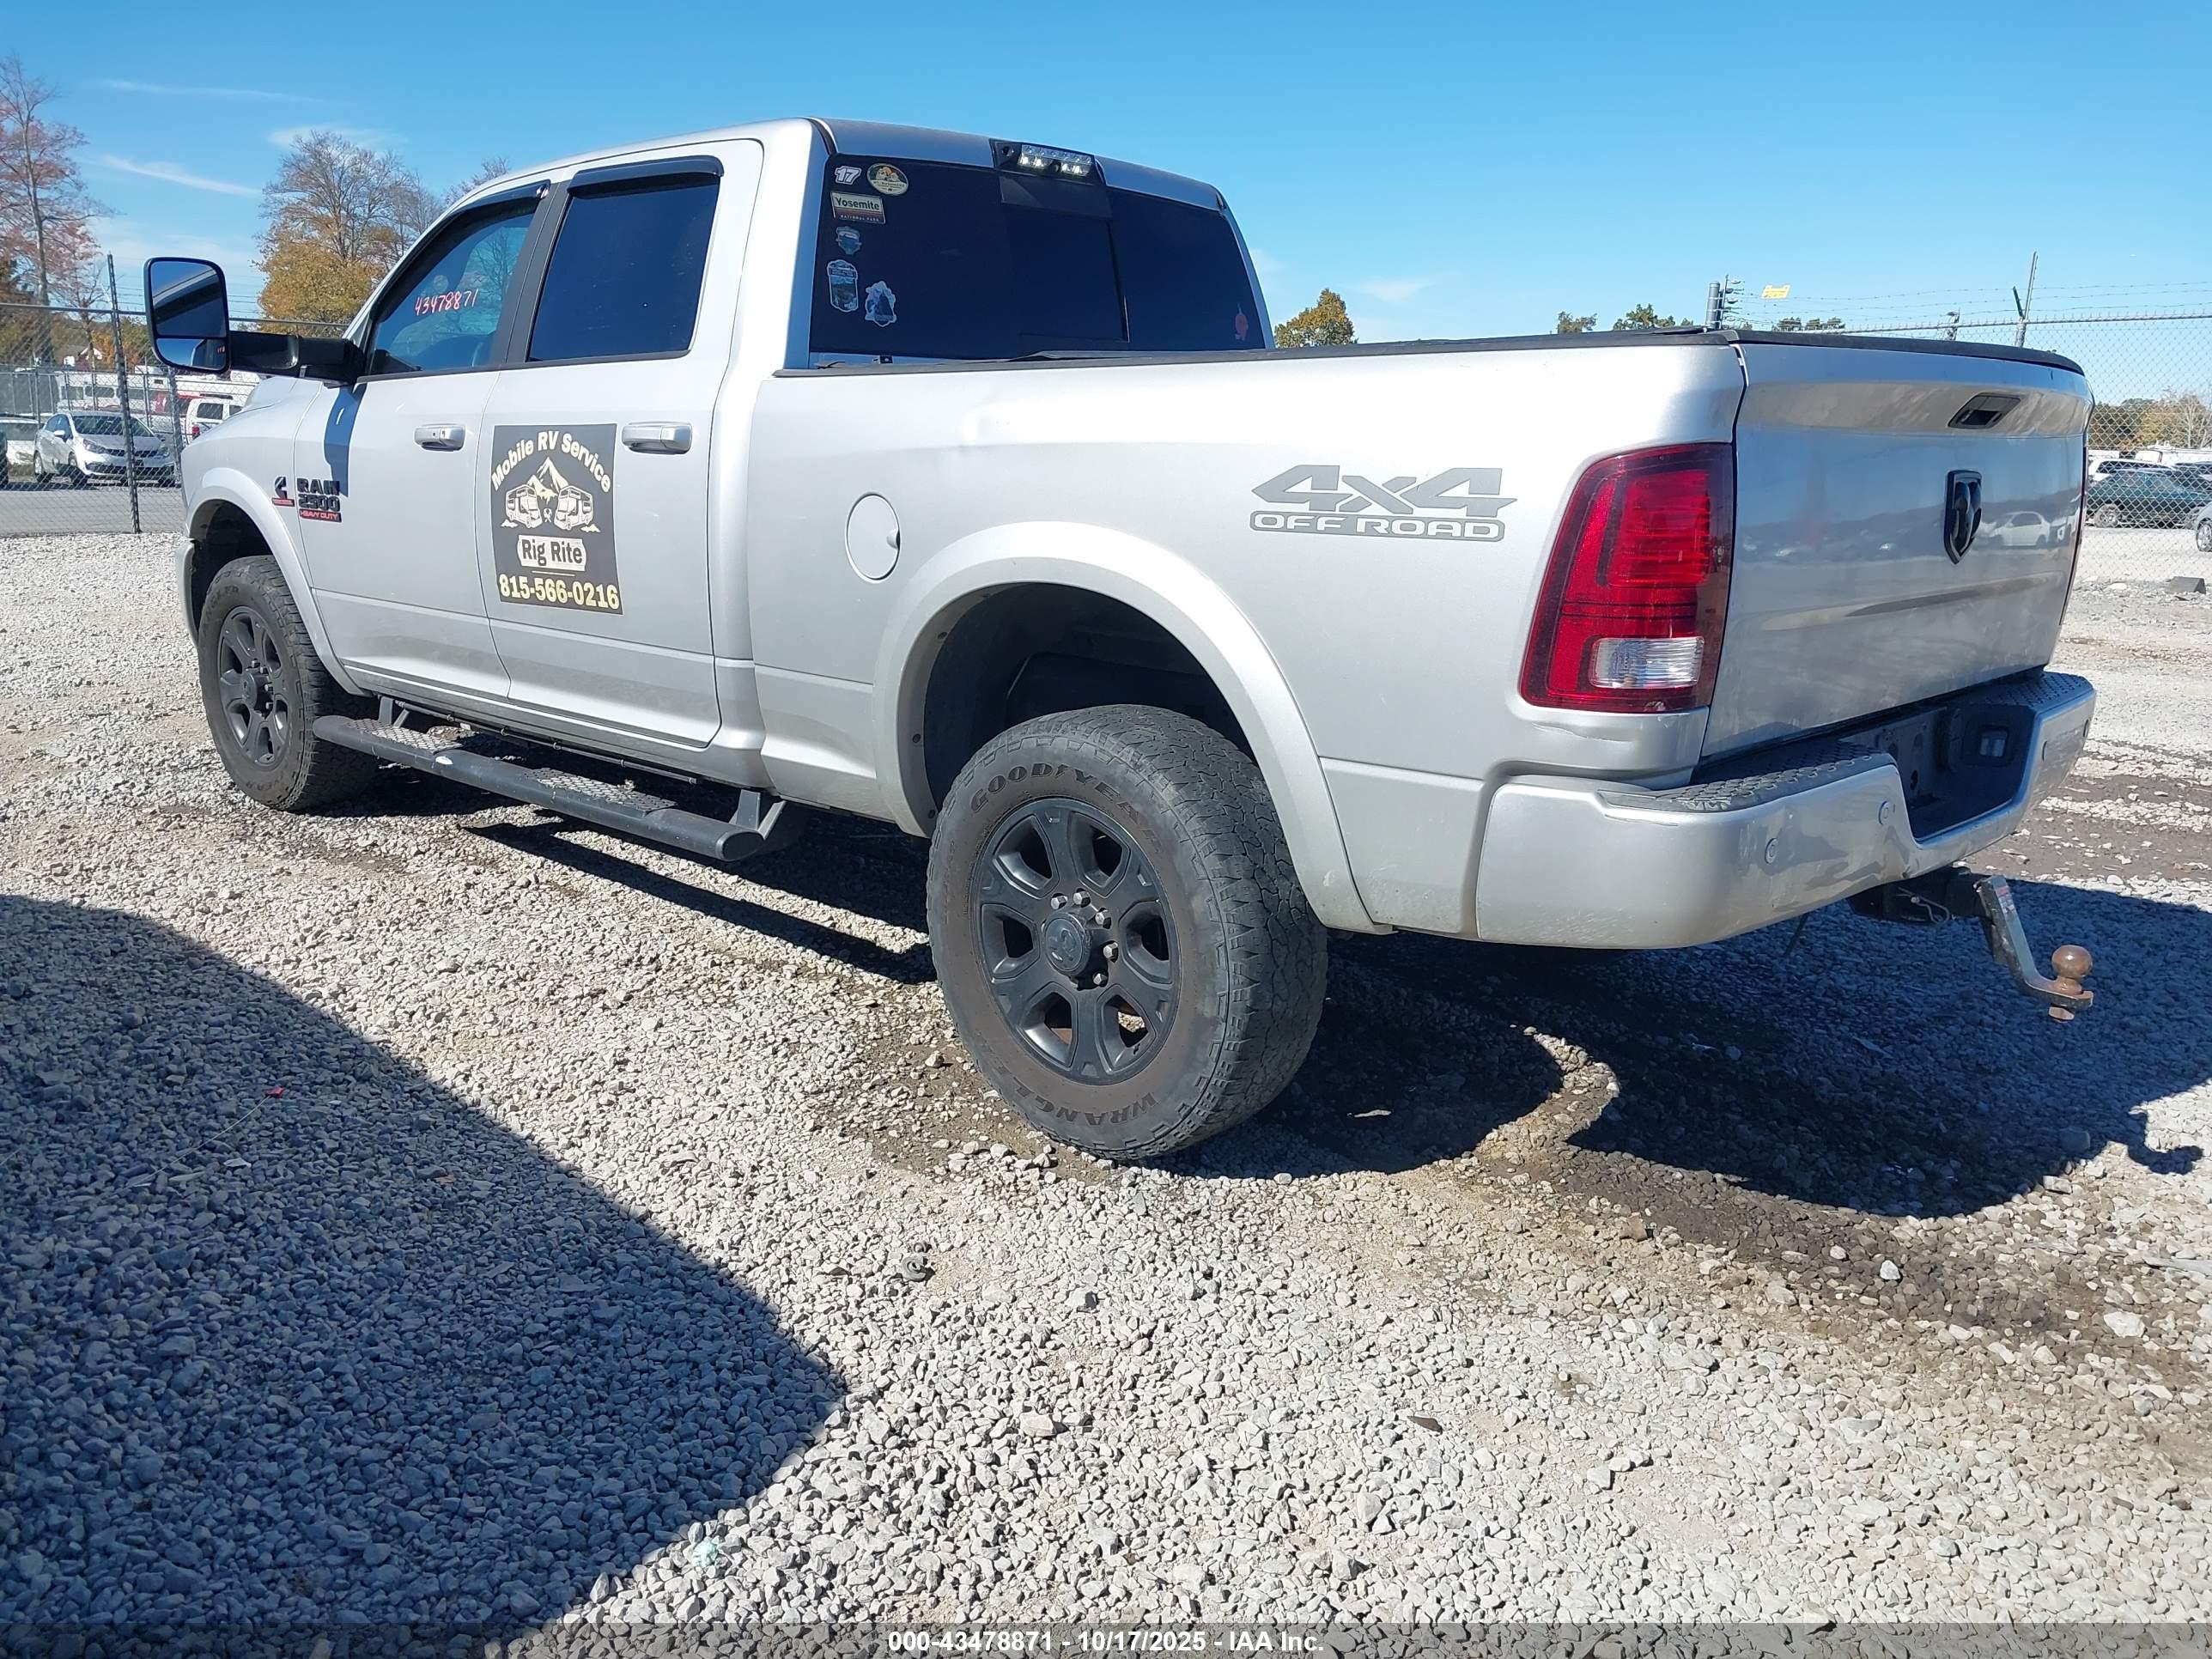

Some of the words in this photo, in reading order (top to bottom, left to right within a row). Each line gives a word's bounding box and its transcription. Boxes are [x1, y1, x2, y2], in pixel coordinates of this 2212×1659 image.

[835, 166, 861, 184] 17
[836, 197, 880, 210] Yosemite
[415, 289, 479, 316] 43478871
[491, 440, 534, 490] Mobile
[538, 430, 560, 451] RV
[562, 433, 611, 493] Service
[296, 477, 340, 495] RAM
[298, 494, 340, 512] 2500
[1254, 513, 1348, 531] OFF
[1356, 517, 1500, 538] ROAD
[521, 538, 546, 566] Rig
[550, 540, 583, 564] Rite
[499, 574, 620, 610] 815-566-0216
